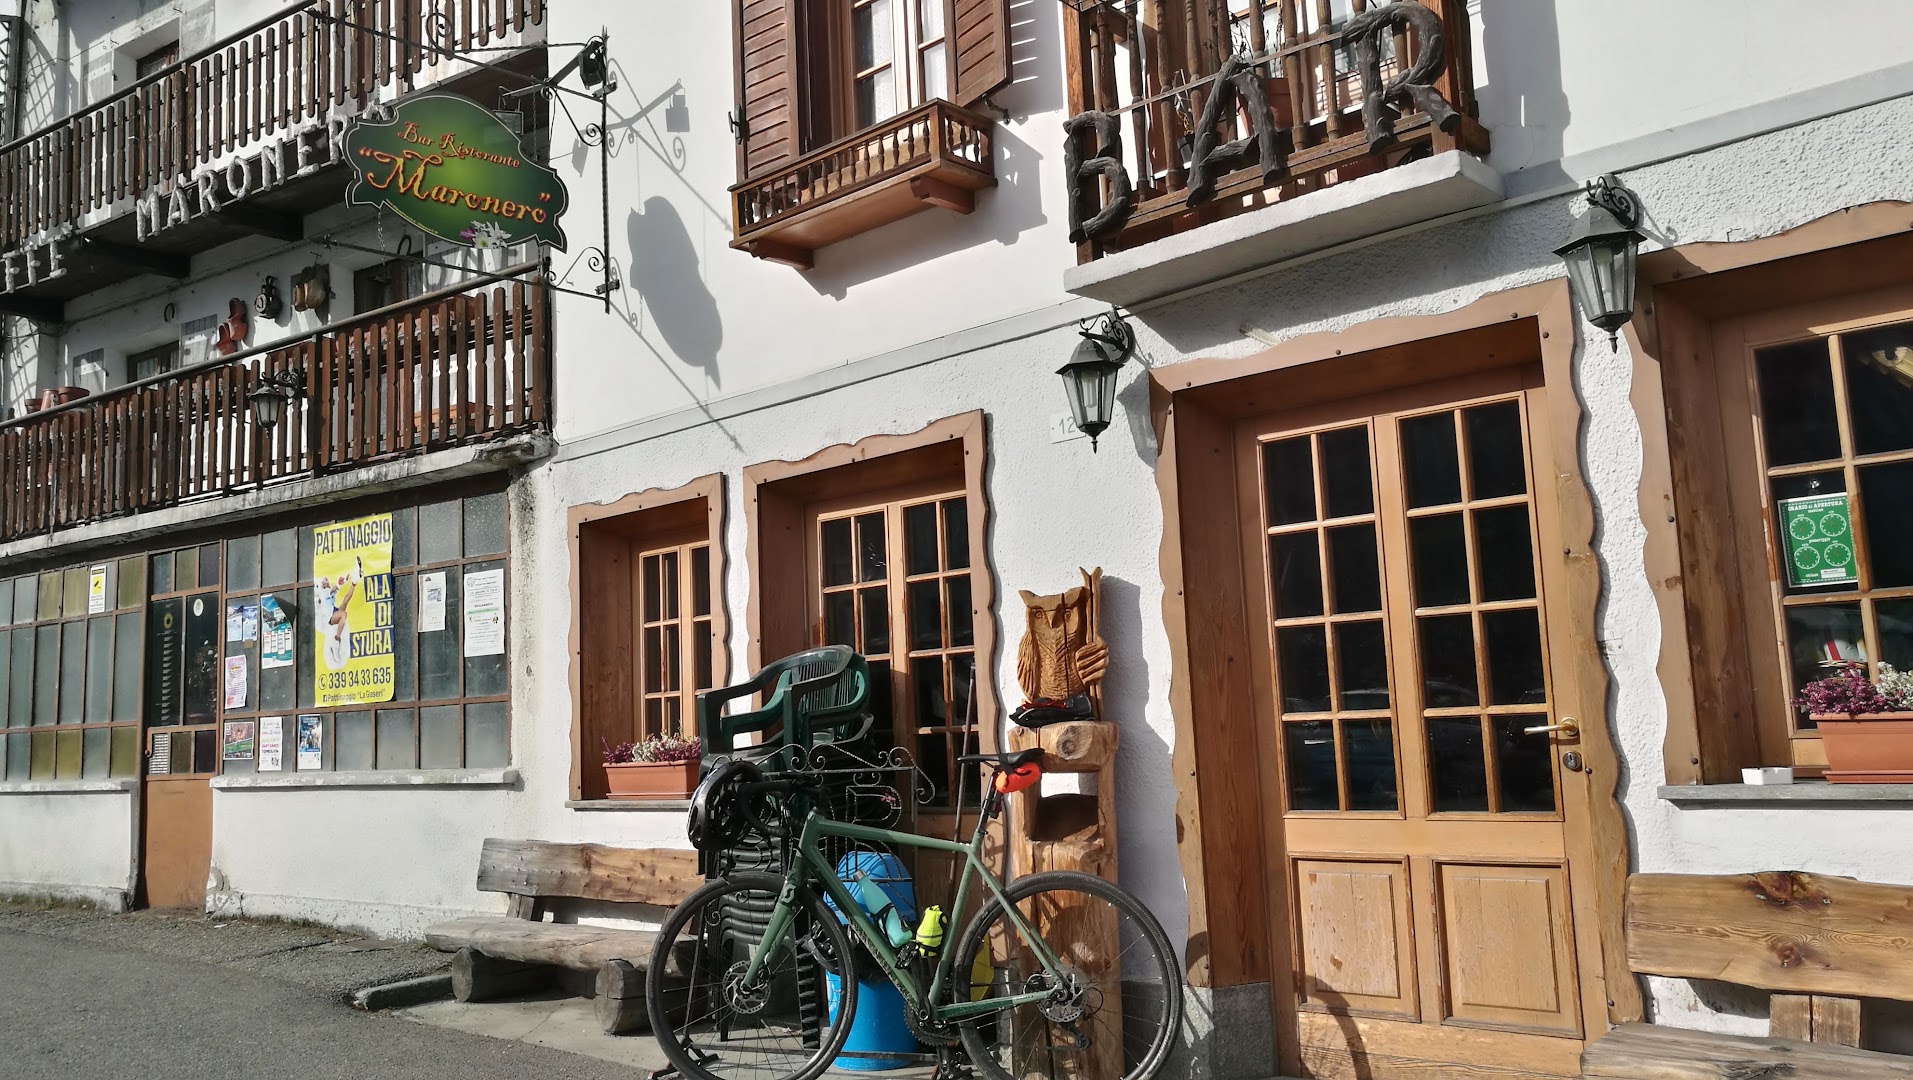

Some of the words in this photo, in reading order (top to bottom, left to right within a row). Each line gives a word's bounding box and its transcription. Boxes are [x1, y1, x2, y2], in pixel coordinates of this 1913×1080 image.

[1063, 1, 1460, 243] BAR
[397, 121, 434, 146] Bar
[440, 133, 520, 168] Ristorante
[1059, 416, 1075, 435] 12
[1814, 500, 1843, 508] APERTURA
[315, 517, 391, 556] PATTINAGGIO
[366, 574, 391, 602] ALA
[377, 602, 391, 628] DI
[352, 629, 392, 657] STURA
[328, 672, 347, 689] 339
[348, 670, 360, 687] 34
[361, 669, 371, 686] 33
[372, 667, 391, 684] 635
